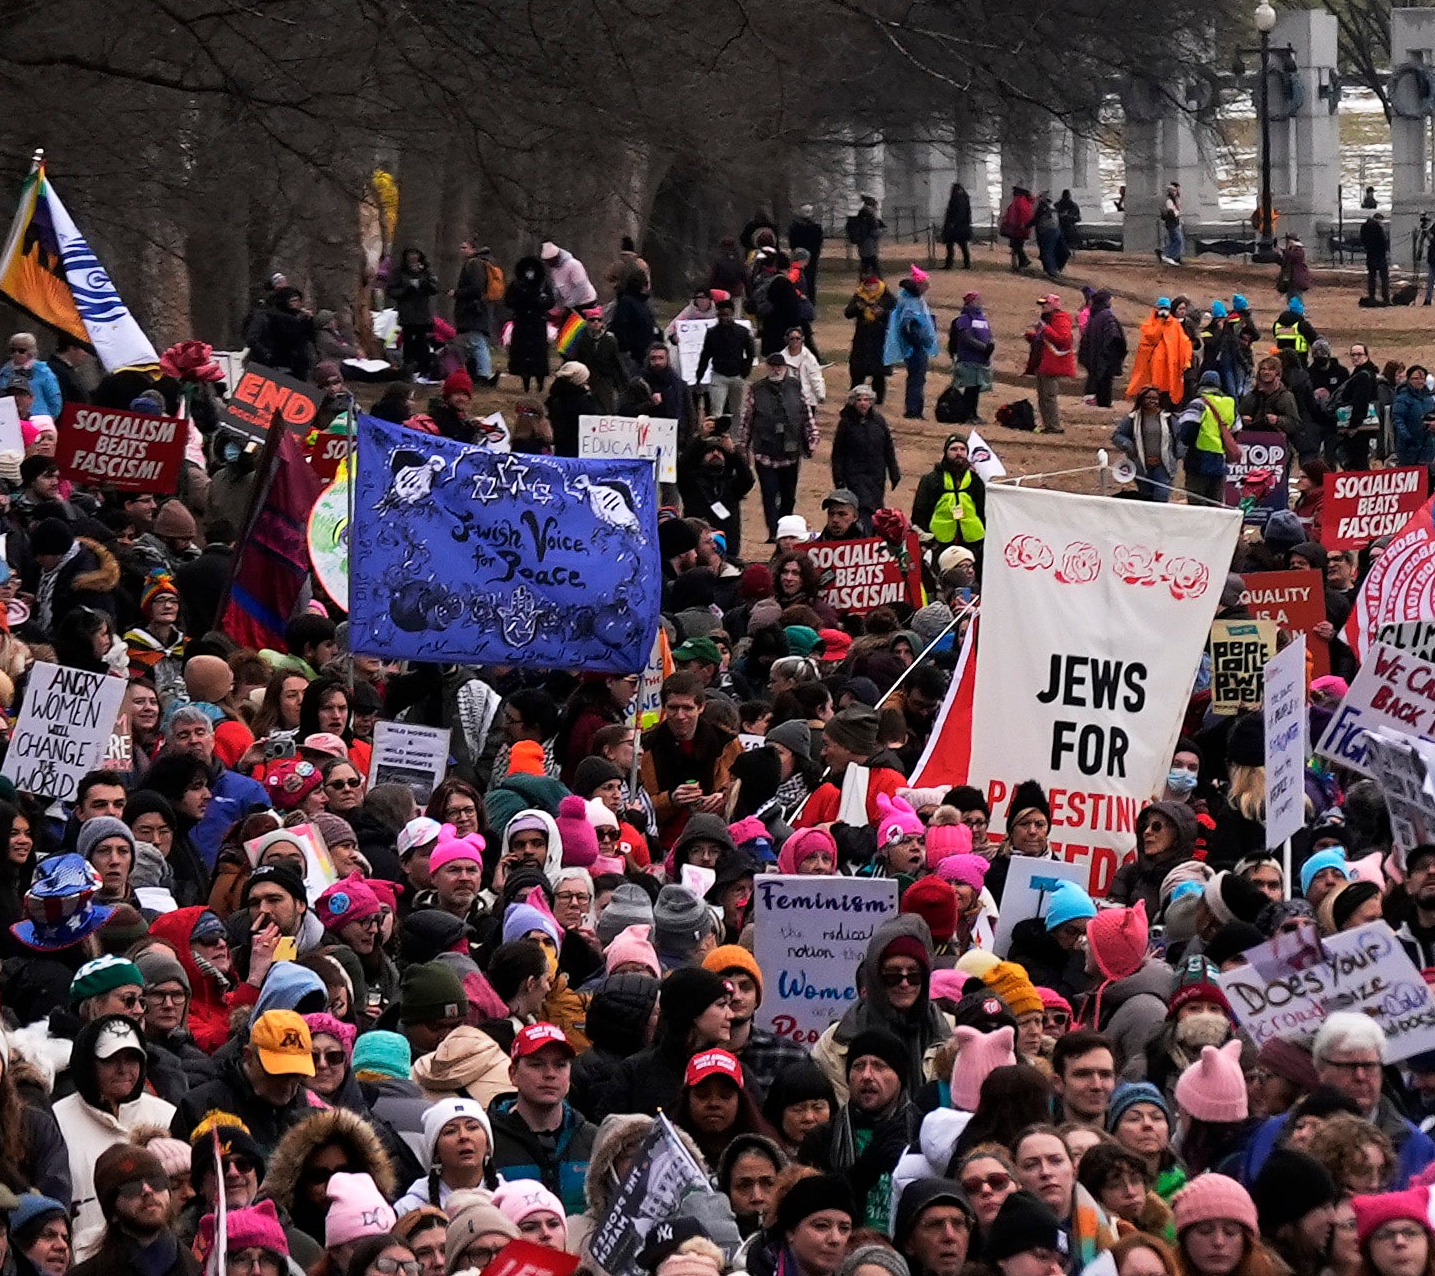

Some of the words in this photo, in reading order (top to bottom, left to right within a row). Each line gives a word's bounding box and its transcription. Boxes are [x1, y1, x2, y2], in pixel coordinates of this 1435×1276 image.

[234, 372, 317, 425] END
[72, 409, 178, 444] SOCIALISM
[95, 435, 149, 460] BEATS
[1239, 443, 1285, 466] TOP
[70, 449, 165, 481] FASCISM!
[1334, 470, 1420, 499] SOCIALISM
[1356, 492, 1399, 516] BEATS
[520, 510, 591, 563] Voice
[472, 547, 496, 574] for
[835, 565, 885, 588] BEATS
[1374, 647, 1406, 685] WE
[48, 667, 106, 701] ANGRY
[1036, 653, 1148, 713] JEWS
[31, 689, 102, 729] WOMEN
[1370, 685, 1426, 727] BACK
[16, 732, 92, 767] CHANGE
[1050, 720, 1129, 778] FOR
[15, 765, 75, 798] WORLD
[38, 759, 57, 773] THE
[758, 880, 896, 913] Feminism:
[780, 926, 803, 940] the
[822, 921, 875, 941] radical
[787, 943, 835, 959] notion
[778, 968, 857, 1001] Wome
[625, 1166, 643, 1196] THE
[596, 1214, 631, 1266] MARCH
